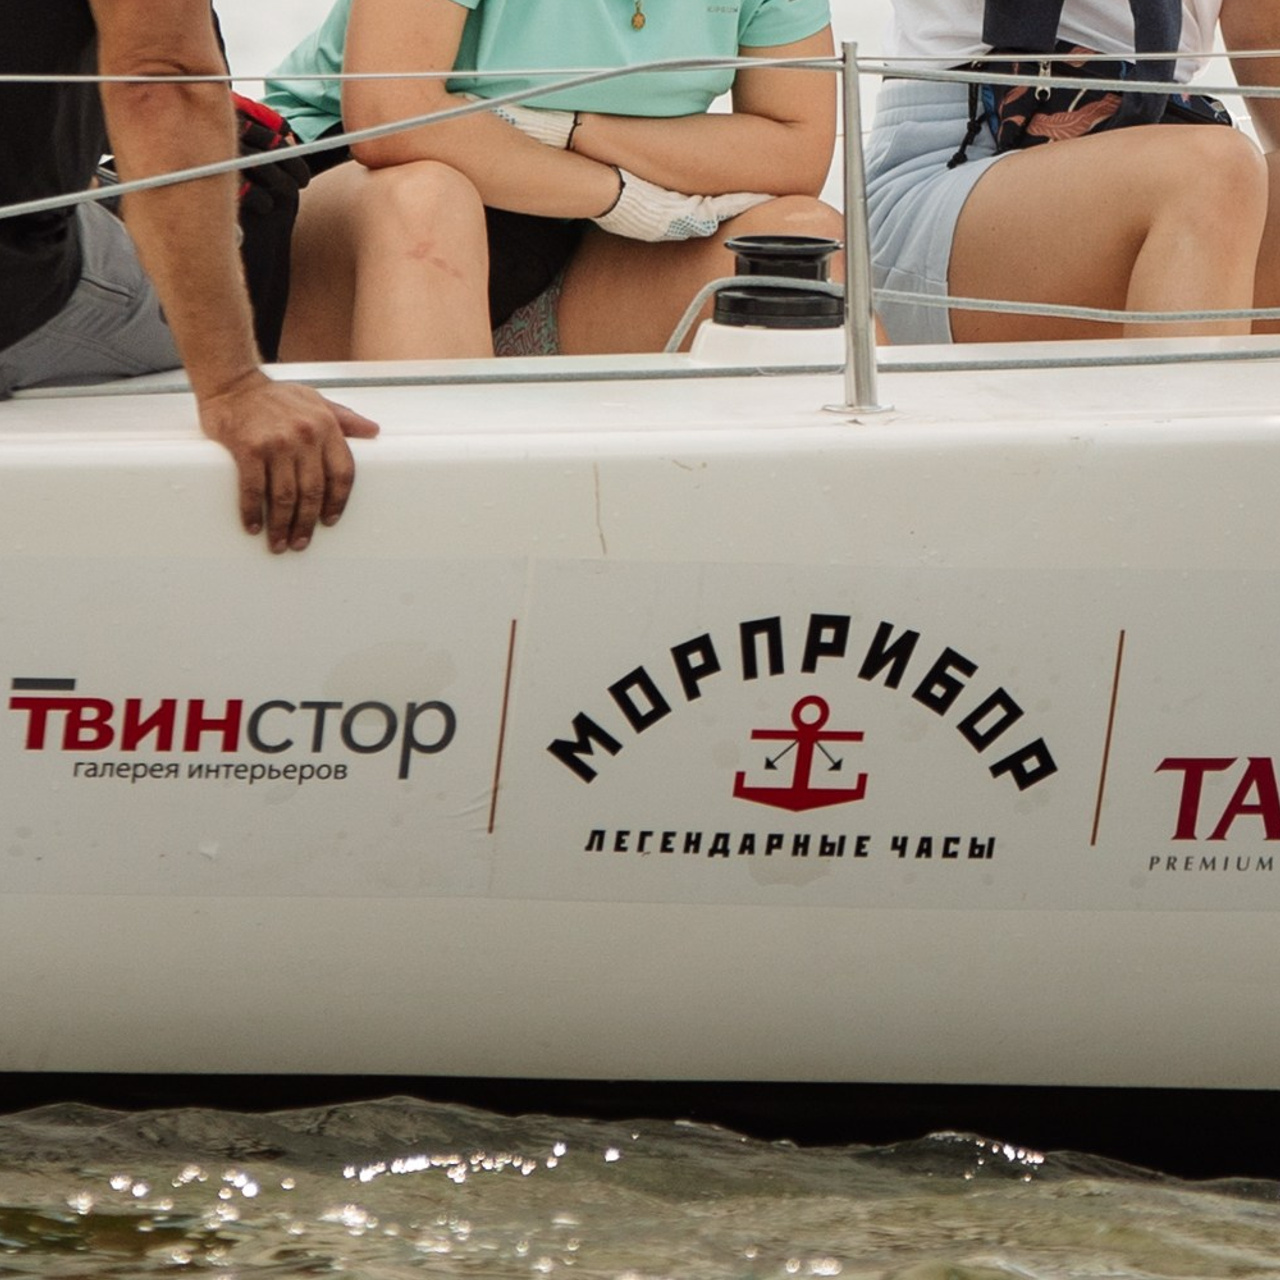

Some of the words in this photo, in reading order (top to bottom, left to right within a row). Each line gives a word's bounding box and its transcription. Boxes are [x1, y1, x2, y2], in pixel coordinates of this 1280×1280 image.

[546, 613, 1058, 791] МОРПРИБОР
[73, 761, 180, 784] галерея
[187, 762, 348, 785] интерьеров
[584, 829, 871, 858] ЛЕГЕНДАРНЫЕ
[890, 835, 996, 859] ЧАСЫ
[1148, 856, 1274, 872] PREMIUM
